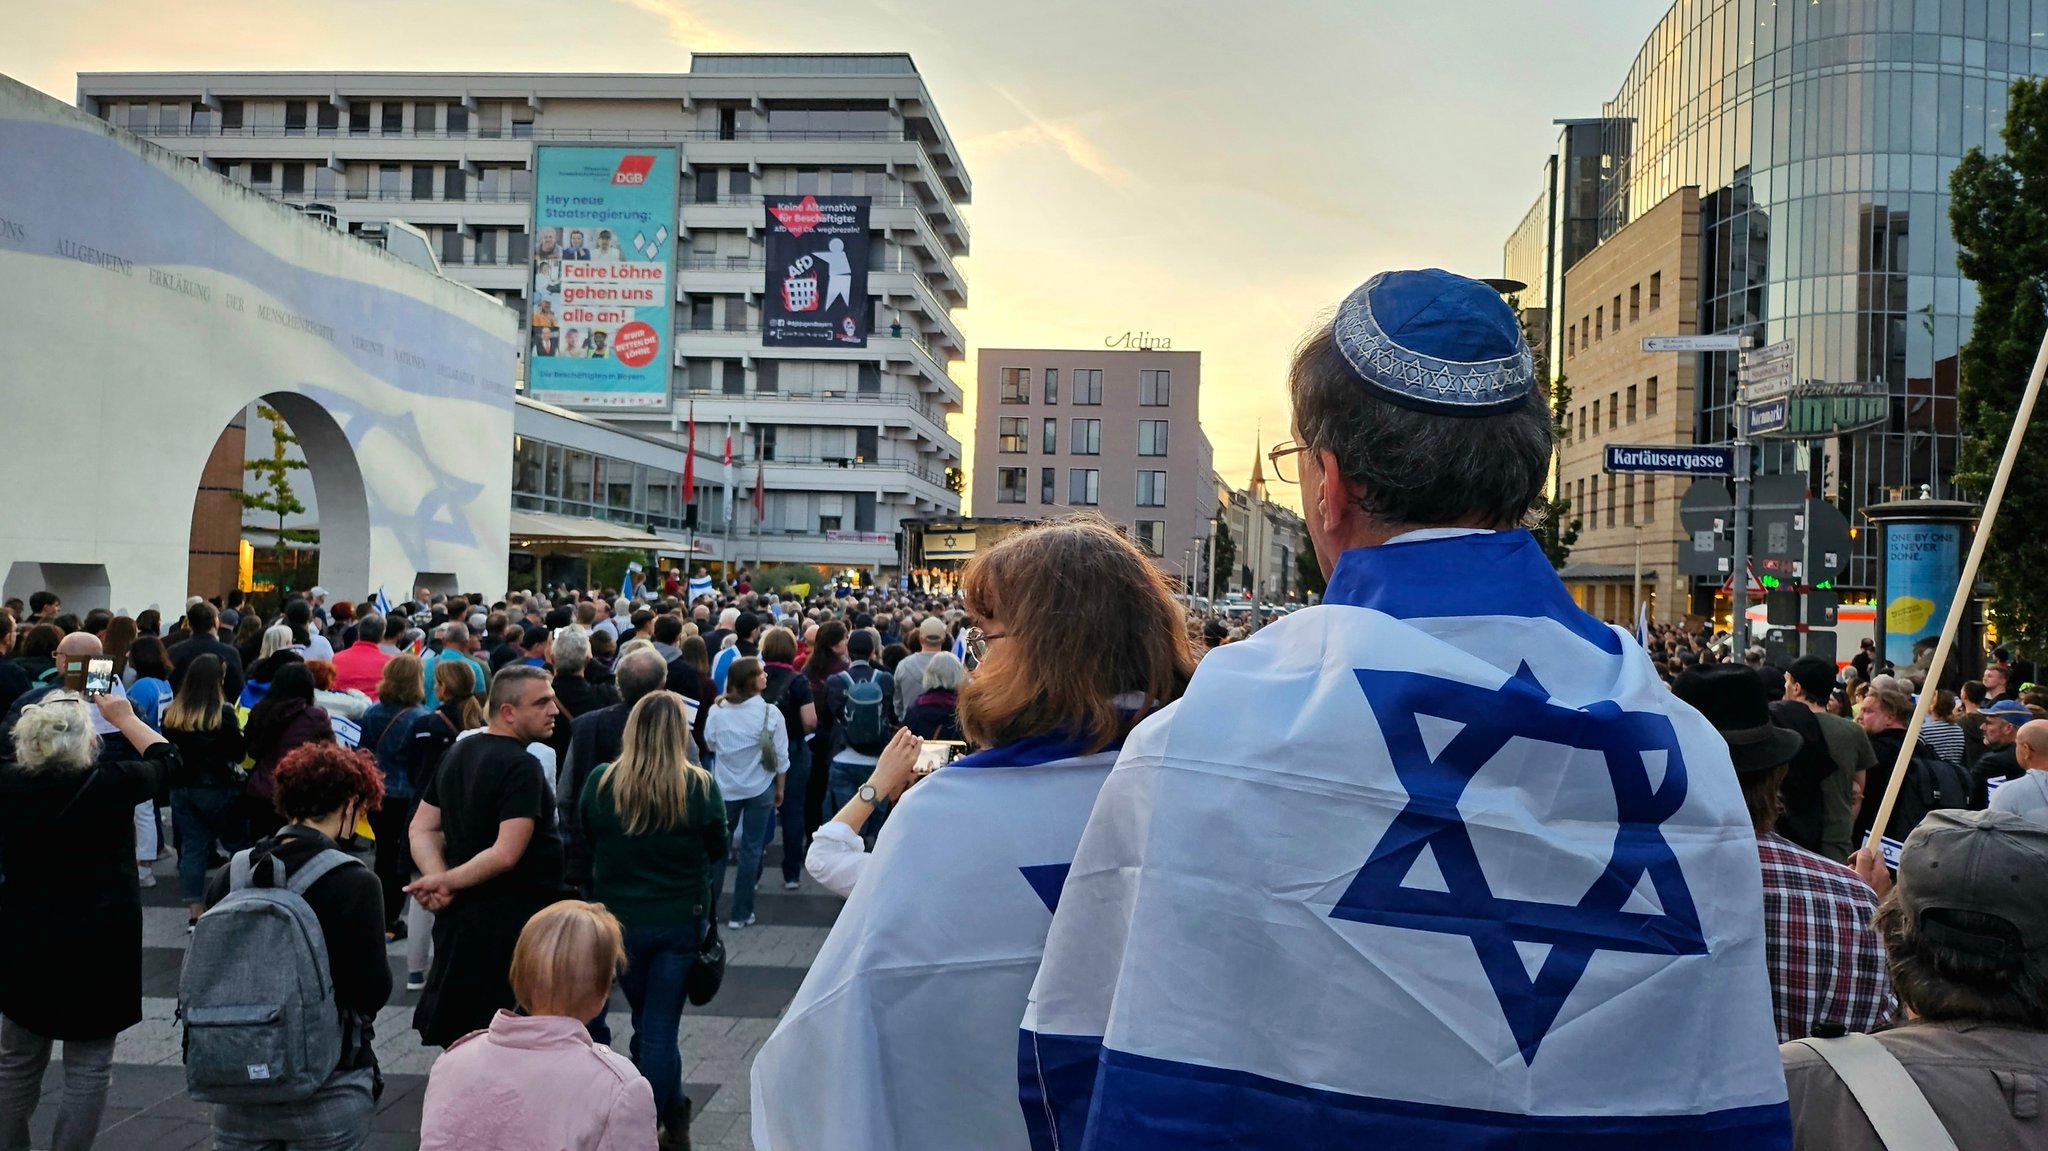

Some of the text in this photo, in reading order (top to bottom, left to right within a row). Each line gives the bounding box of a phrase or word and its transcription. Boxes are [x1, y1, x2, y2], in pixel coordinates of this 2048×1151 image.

[616, 173, 643, 184] DGB
[545, 195, 604, 207] Hey neue
[778, 203, 857, 212] Keine Alternative
[545, 208, 652, 223] Staatsregierung:
[779, 214, 856, 224] für Beschäftigte:
[817, 226, 861, 234] wegbrezeln!
[565, 263, 662, 279] Faire Löhne
[787, 254, 814, 279] AfD
[55, 238, 134, 277] ALLGEMEINE
[148, 267, 211, 303] ERKLÄRUNG
[225, 293, 245, 313] DER
[257, 304, 336, 342] MENSCHENRECHTE
[564, 286, 653, 303] gehen uns
[563, 308, 626, 323] alle an!
[1105, 331, 1172, 349] Adina
[1614, 448, 1724, 469] Kartäusergasse
[1891, 533, 1953, 542] ONE BY ONE
[1891, 543, 1937, 551] IS NEVER
[1891, 552, 1922, 561] DONE.
